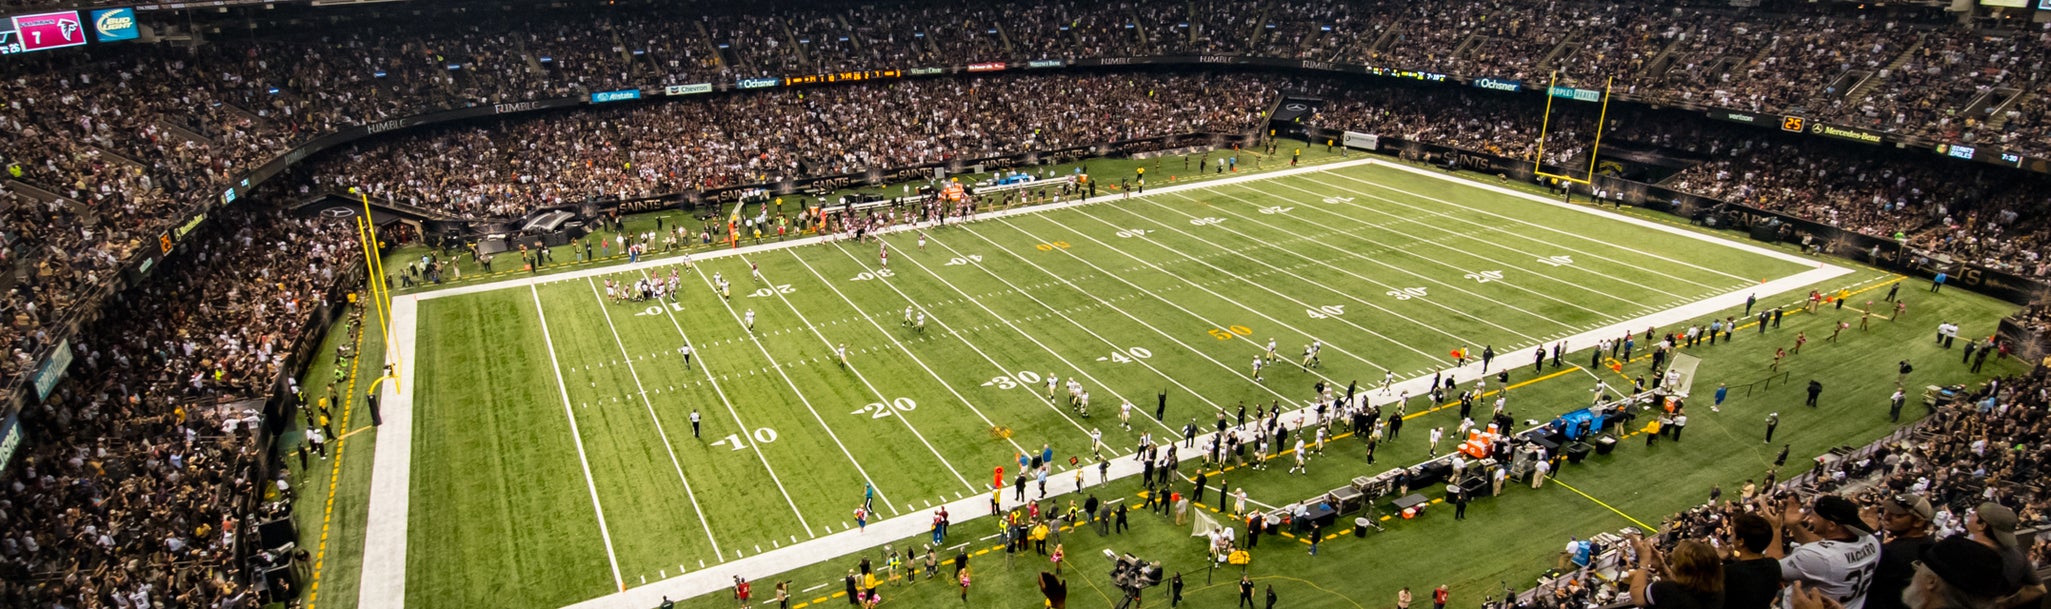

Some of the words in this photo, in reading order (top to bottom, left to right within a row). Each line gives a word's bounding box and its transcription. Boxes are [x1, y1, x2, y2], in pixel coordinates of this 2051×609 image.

[102, 22, 133, 31] LIGHT
[106, 17, 131, 25] BUD
[32, 31, 41, 45] 7
[681, 86, 709, 94] Chevron
[743, 78, 775, 90] Ochsner
[1481, 78, 1517, 91] Ochsner
[609, 91, 635, 101] Allstate
[1574, 89, 1600, 101] HEALTH
[1728, 113, 1755, 123] verizon
[1784, 117, 1802, 131] 25
[1825, 127, 1882, 143] Mercedes-Benz
[1443, 151, 1489, 171] SINTS
[899, 167, 934, 180] SAINTS
[812, 176, 850, 193] SAINTS
[618, 197, 665, 216] SAINTS
[1208, 324, 1253, 341] 50
[1110, 346, 1152, 364] 40
[990, 370, 1041, 391] 30
[864, 397, 917, 419] 20
[722, 427, 778, 451] 10
